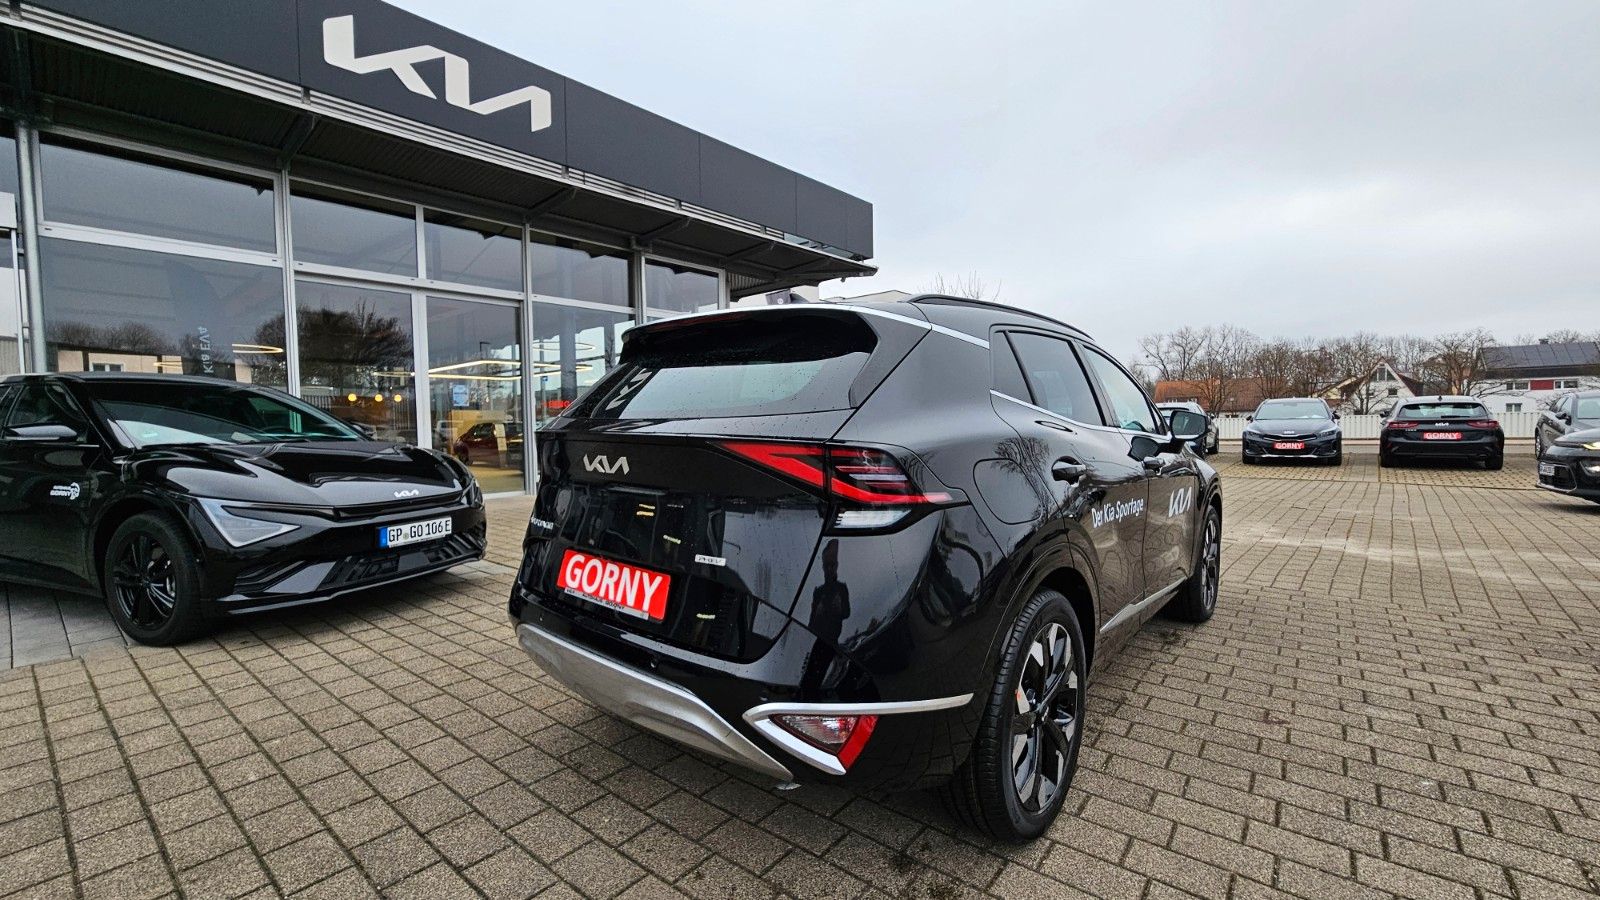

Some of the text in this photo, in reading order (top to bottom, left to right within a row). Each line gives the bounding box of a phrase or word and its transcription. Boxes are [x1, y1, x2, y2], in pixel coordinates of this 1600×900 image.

[322, 14, 551, 132] KIA
[1275, 442, 1303, 450] GORNY
[1426, 432, 1457, 440] GORNY
[583, 454, 630, 475] KIA
[1091, 498, 1144, 529] Der Kia Sportage
[1168, 486, 1192, 518] KIA
[388, 528, 403, 542] GP
[410, 524, 423, 538] GO
[565, 554, 663, 612] GORNY
